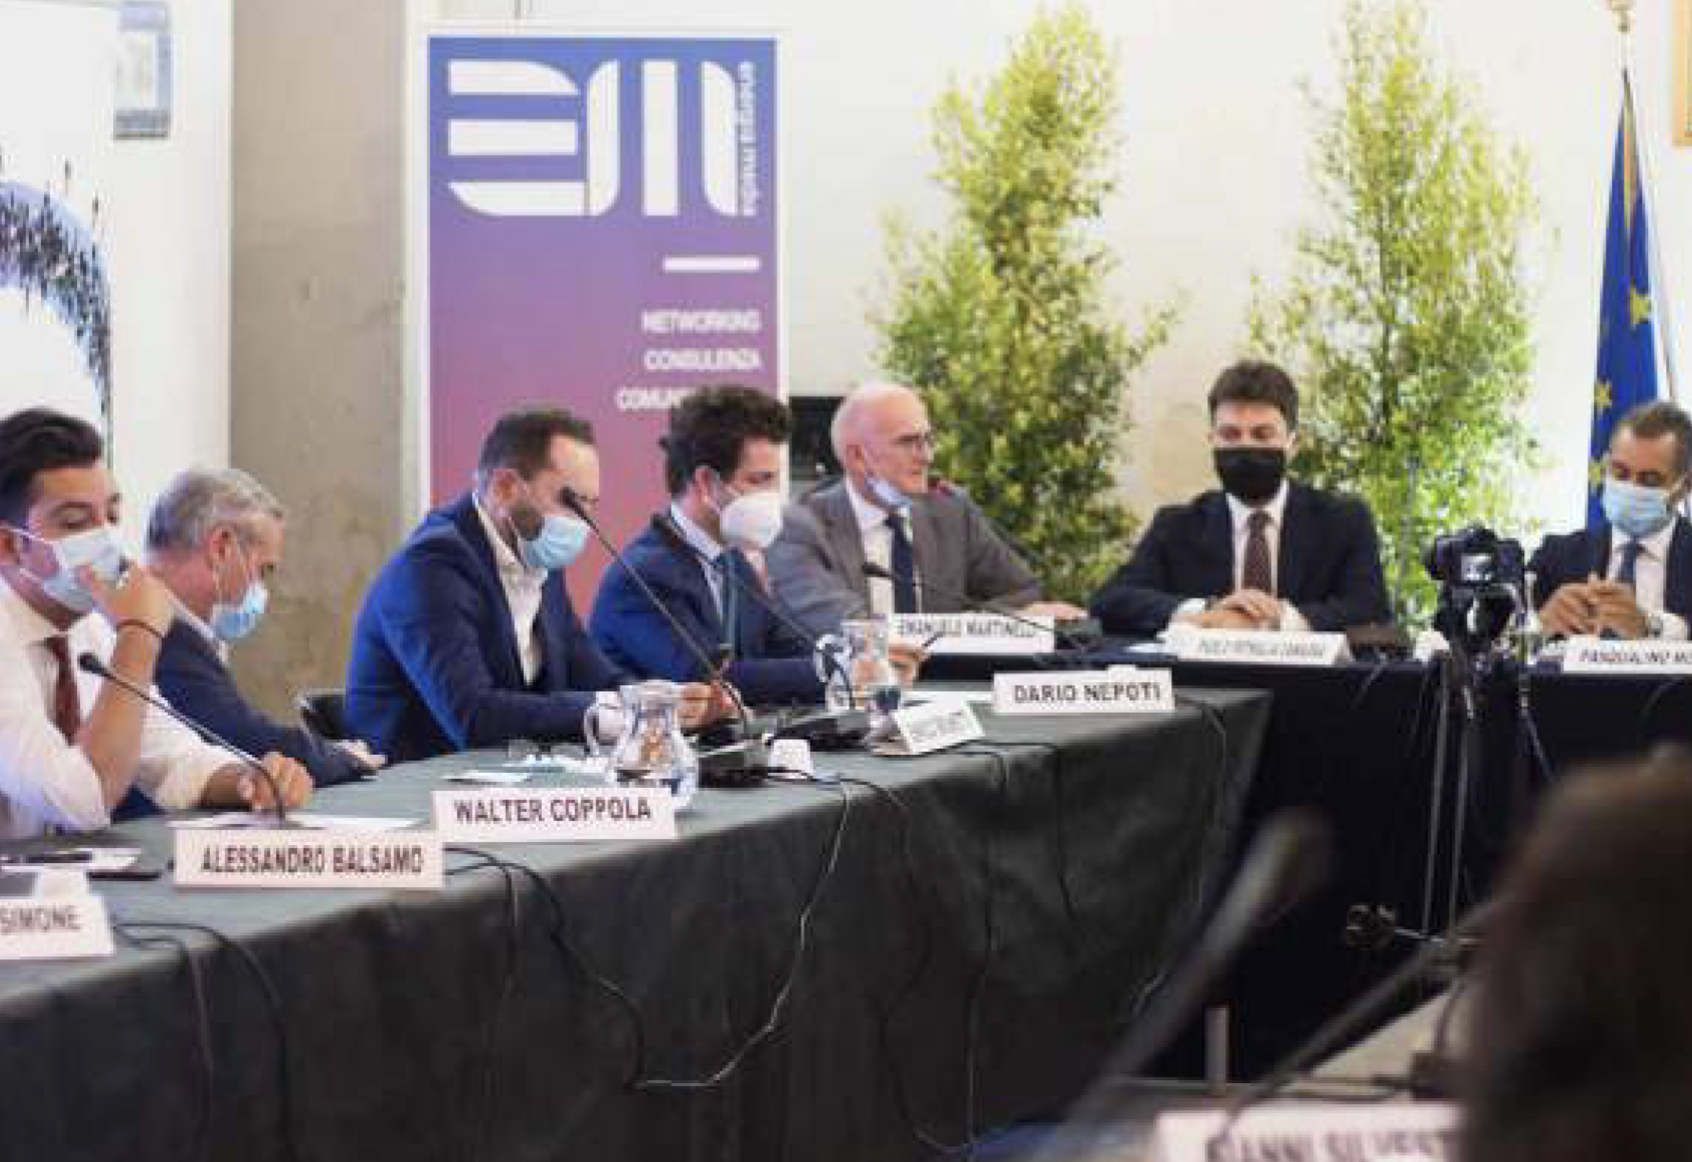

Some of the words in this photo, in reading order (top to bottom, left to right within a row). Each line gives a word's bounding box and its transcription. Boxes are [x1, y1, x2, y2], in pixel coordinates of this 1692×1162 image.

[641, 310, 762, 334] NETWORKING
[643, 348, 762, 371] CONSULENZA
[1014, 684, 1077, 703] DARIO
[1083, 681, 1161, 702] NEPOTI
[454, 799, 544, 821] WALTER
[550, 797, 651, 821] COPPOLA
[201, 844, 325, 873] ALESSANDRO
[333, 846, 424, 872] BALSAMO
